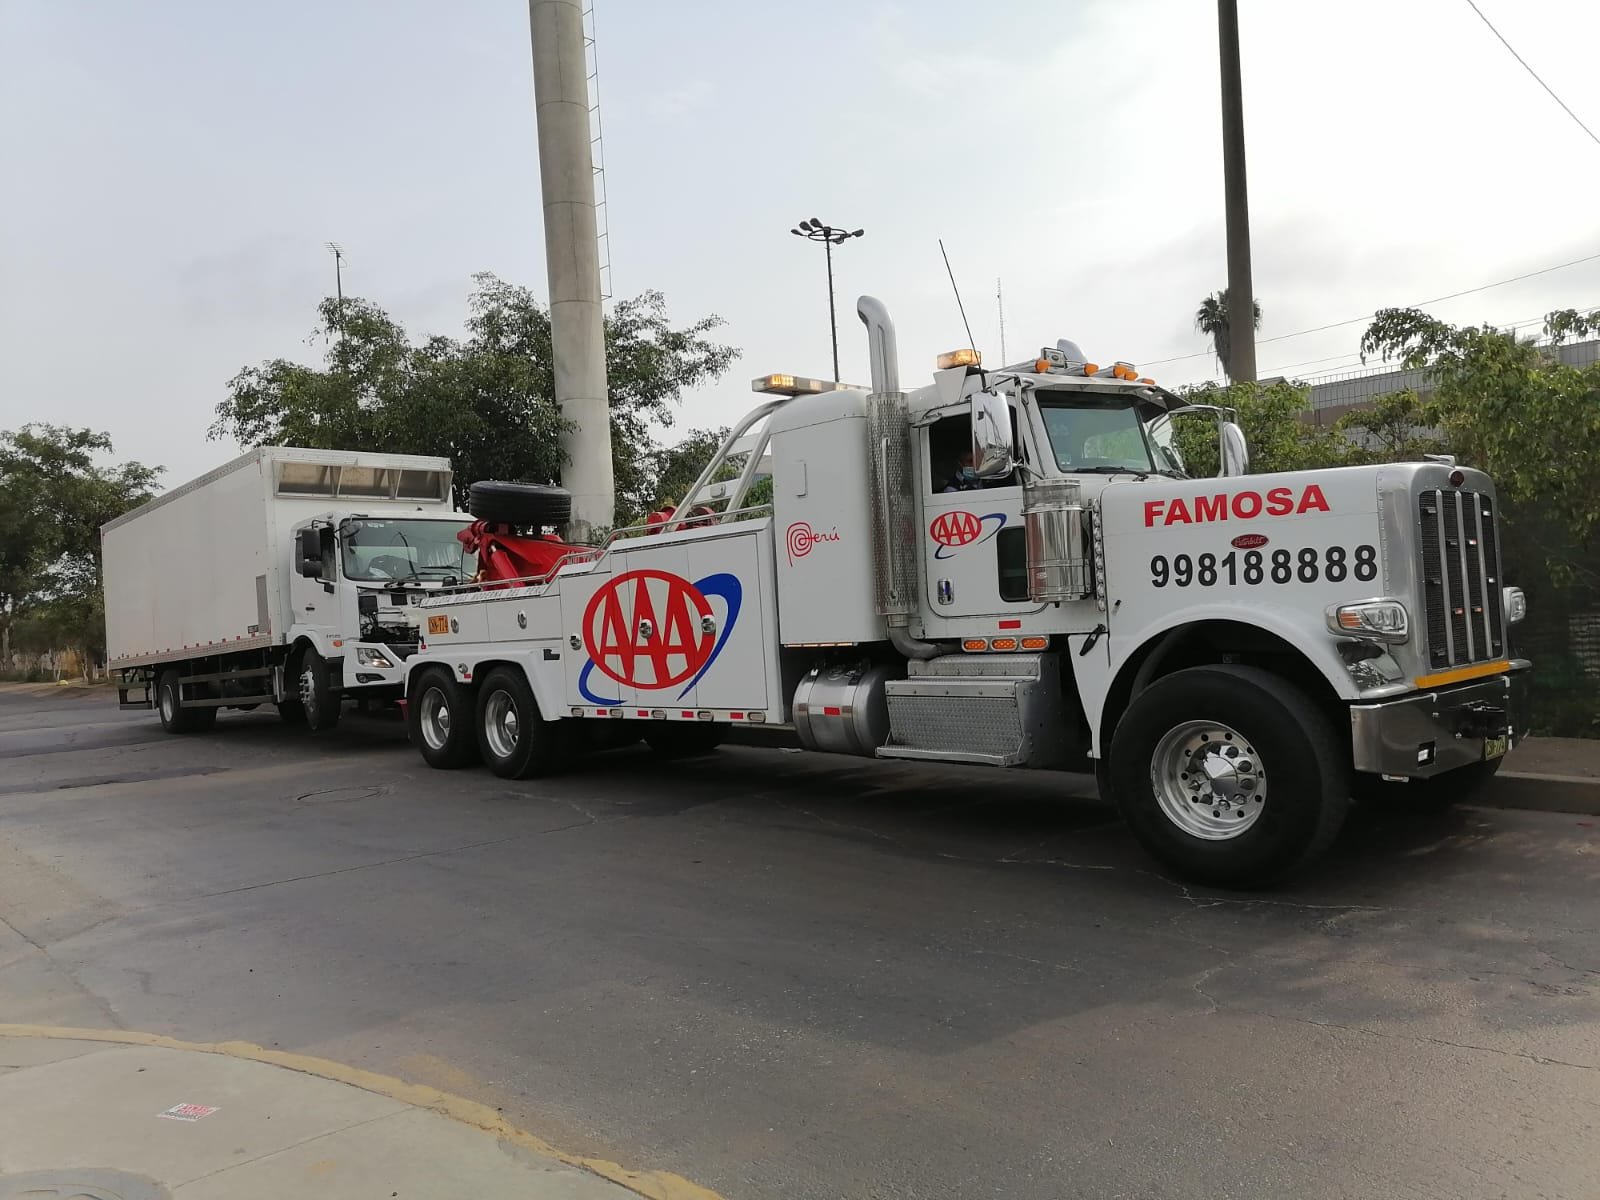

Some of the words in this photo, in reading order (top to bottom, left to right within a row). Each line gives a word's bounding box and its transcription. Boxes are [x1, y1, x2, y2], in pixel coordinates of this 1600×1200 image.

[1144, 484, 1331, 528] FAMOSA
[786, 521, 840, 567] Perú
[930, 511, 982, 546] AAA
[1150, 544, 1378, 588] 998188888
[583, 569, 716, 690] AAA
